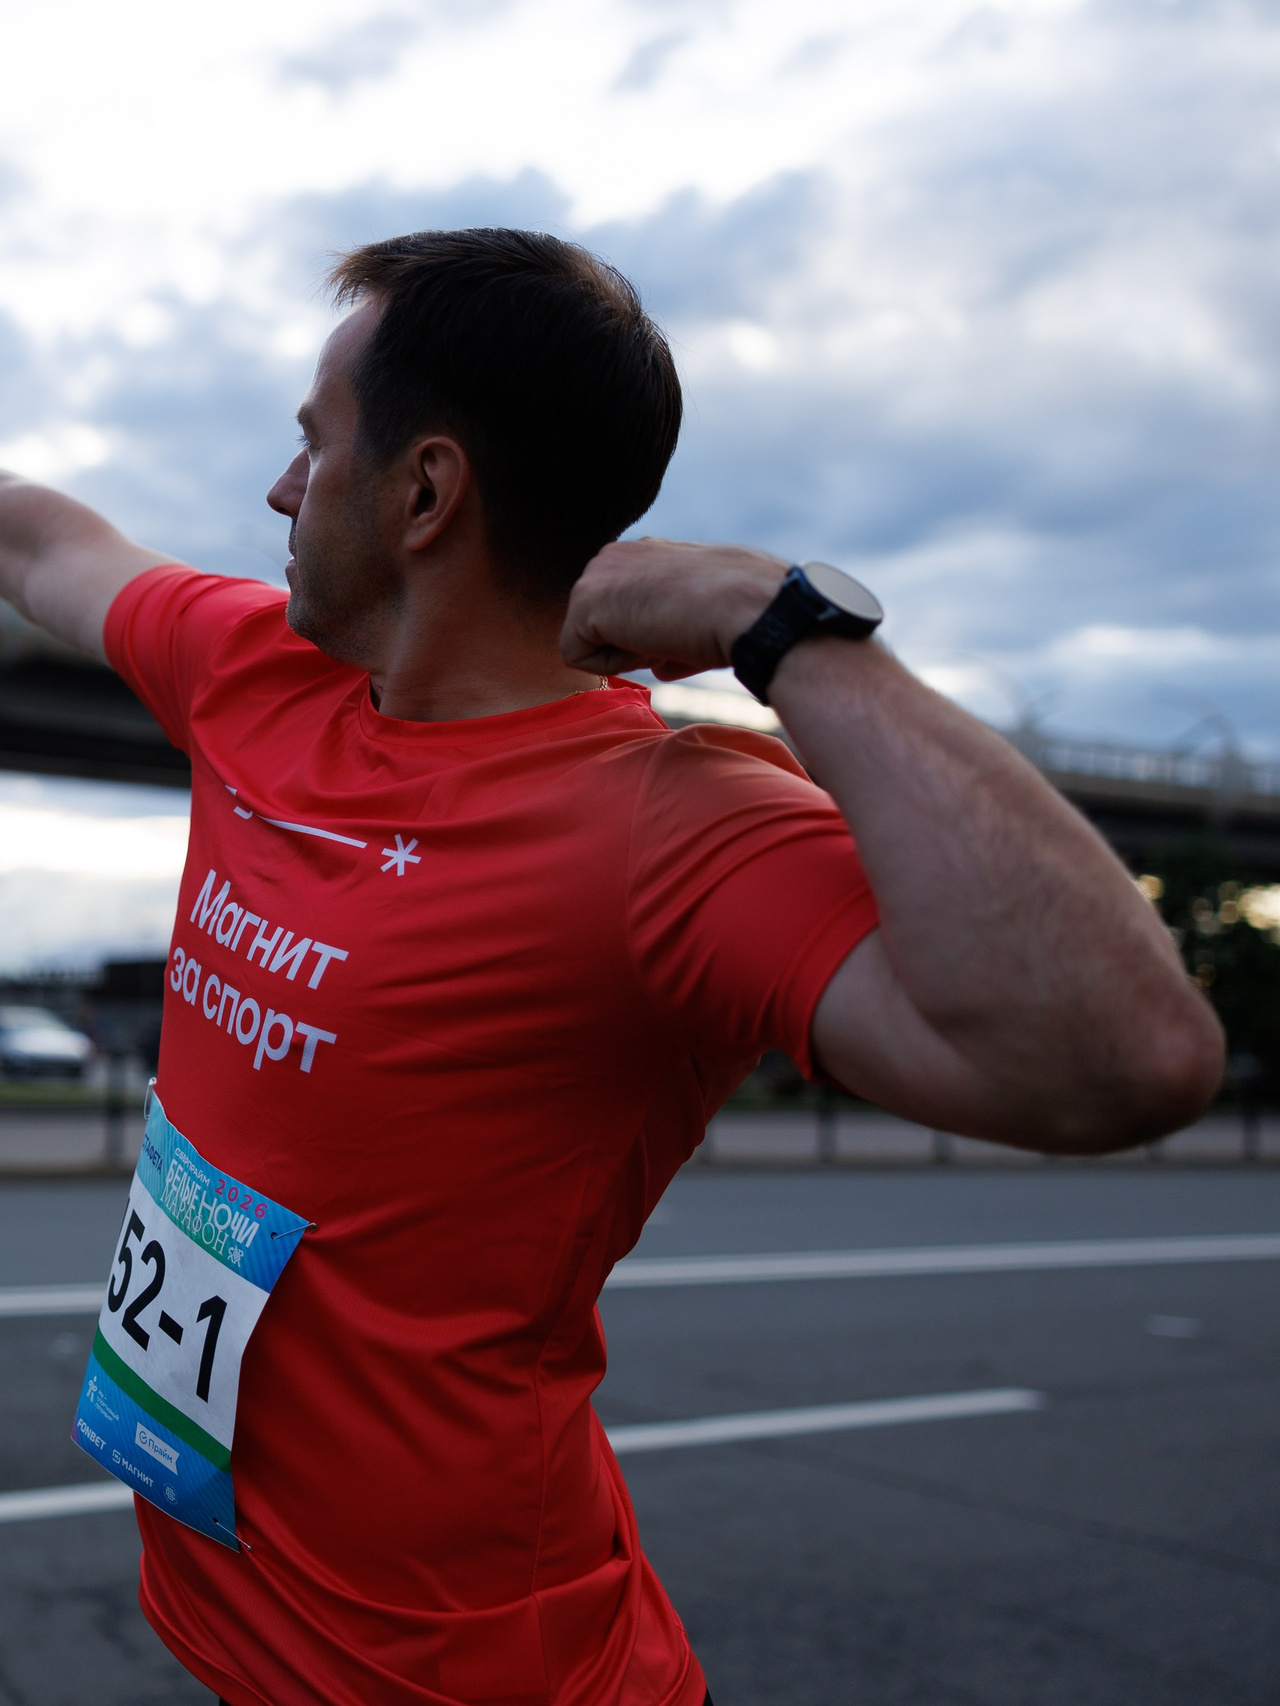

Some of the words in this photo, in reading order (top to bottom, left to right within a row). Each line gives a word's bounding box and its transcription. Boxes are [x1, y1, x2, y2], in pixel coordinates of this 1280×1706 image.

[190, 869, 349, 990] Магнит
[170, 947, 201, 1006] за
[203, 974, 337, 1073] спорт
[142, 1134, 163, 1175] ТАФЕТА
[175, 1148, 210, 1186] СБЕРПРАЙМ
[165, 1158, 201, 1210] БЕЛЫЕ
[198, 1190, 260, 1248] НОЧИ
[215, 1179, 268, 1218] 2026
[160, 1185, 230, 1256] МАРАФОН
[108, 1209, 227, 1404] 52-1
[77, 1418, 106, 1450] FONBET
[148, 1439, 173, 1463] Прайм
[121, 1457, 154, 1487] МАГНИТ
